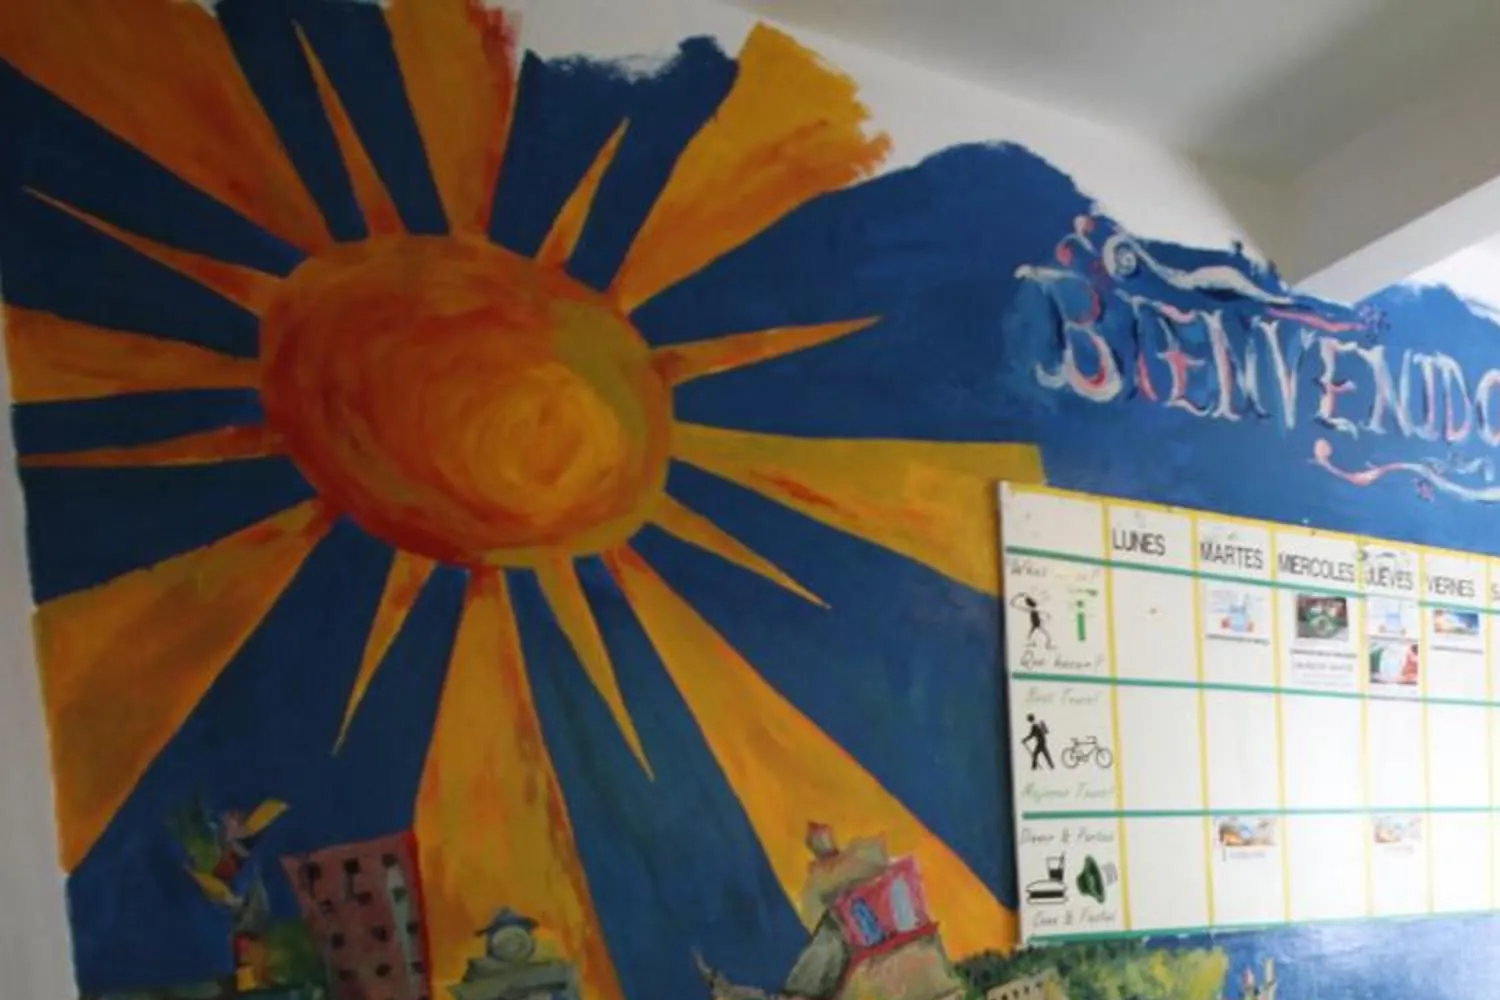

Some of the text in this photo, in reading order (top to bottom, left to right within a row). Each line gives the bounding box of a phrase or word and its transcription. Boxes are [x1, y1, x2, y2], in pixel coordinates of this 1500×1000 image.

[1112, 528, 1166, 556] LUNES
[1201, 542, 1264, 570] MARTES
[1278, 553, 1355, 583] MIERCOLES
[1365, 566, 1413, 590] JUEVES
[1427, 574, 1475, 598] VIERNES
